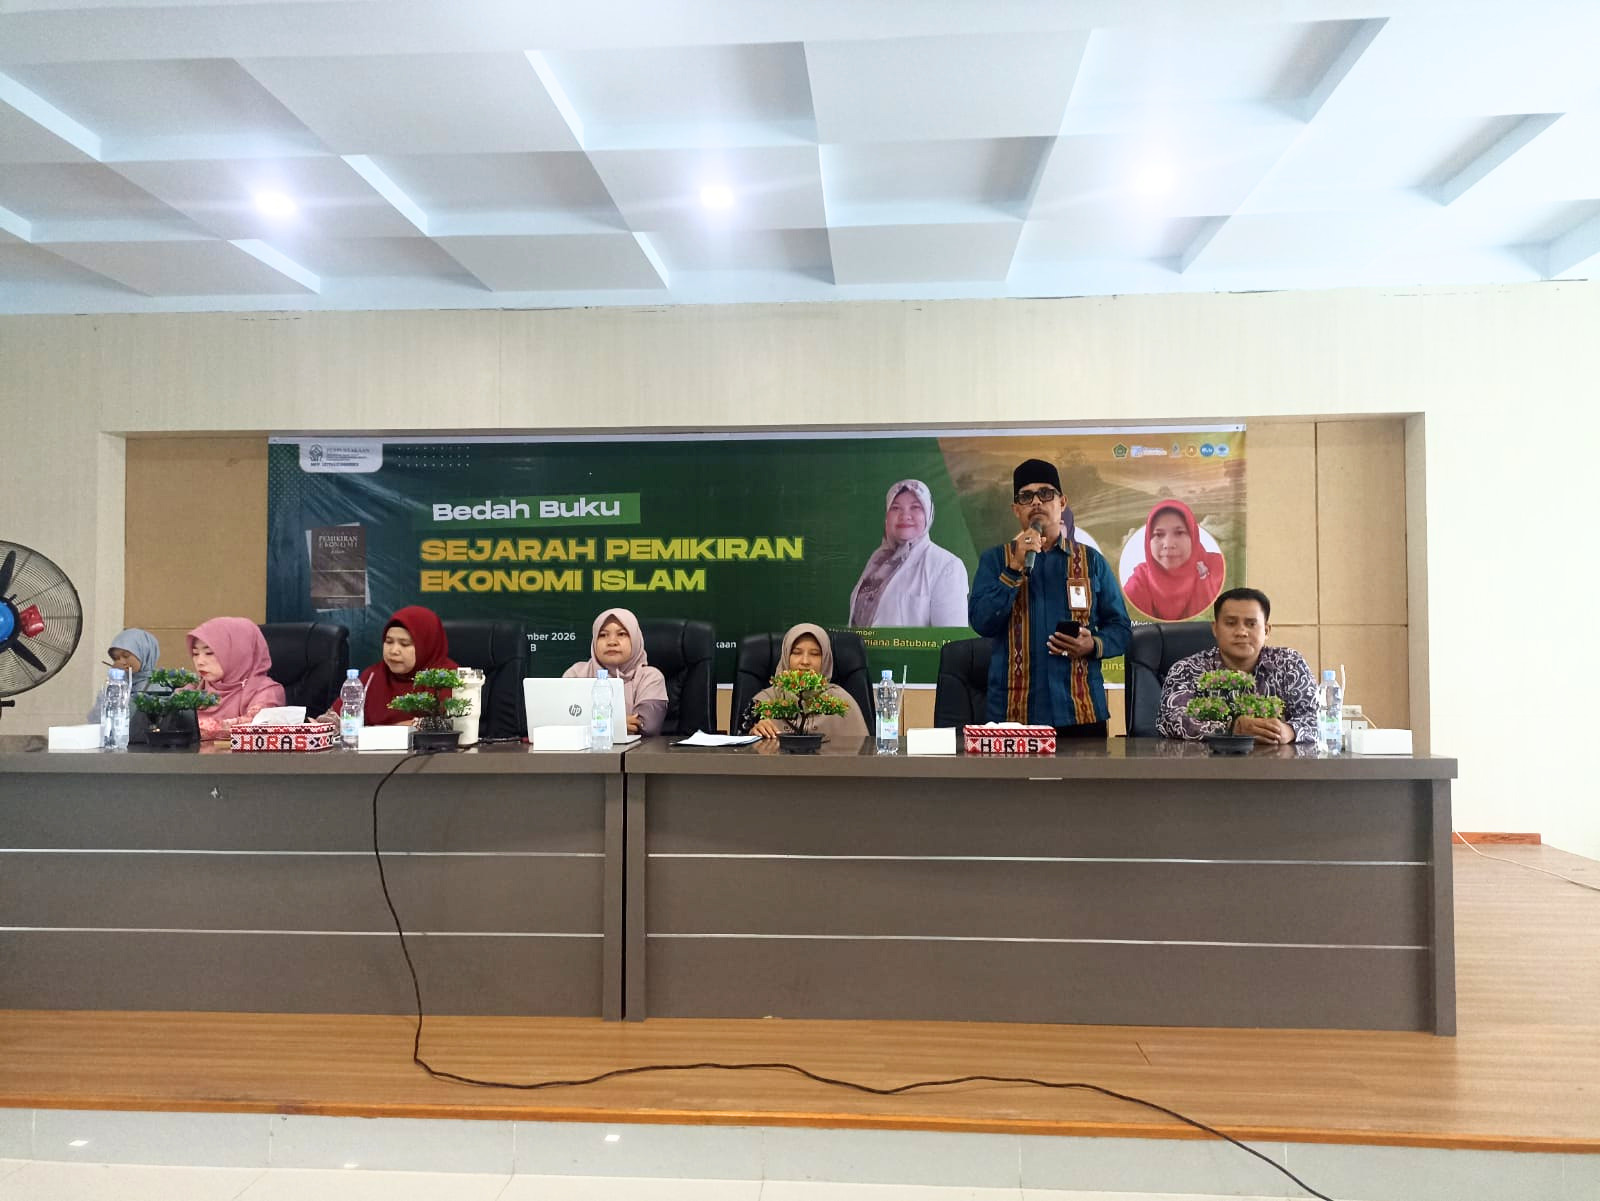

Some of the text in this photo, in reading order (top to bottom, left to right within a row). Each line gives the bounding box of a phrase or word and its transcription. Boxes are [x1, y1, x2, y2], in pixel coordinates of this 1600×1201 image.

[432, 497, 621, 521] Bedah Buku
[420, 537, 804, 562] SEJARAH PEMIKIRAN
[420, 568, 707, 593] EKONOMI ISLAM
[551, 632, 576, 641] 2026
[893, 638, 940, 648] Batubara,
[568, 703, 583, 717] hp
[240, 735, 308, 751] HORAS
[981, 738, 1039, 753] HORAS
